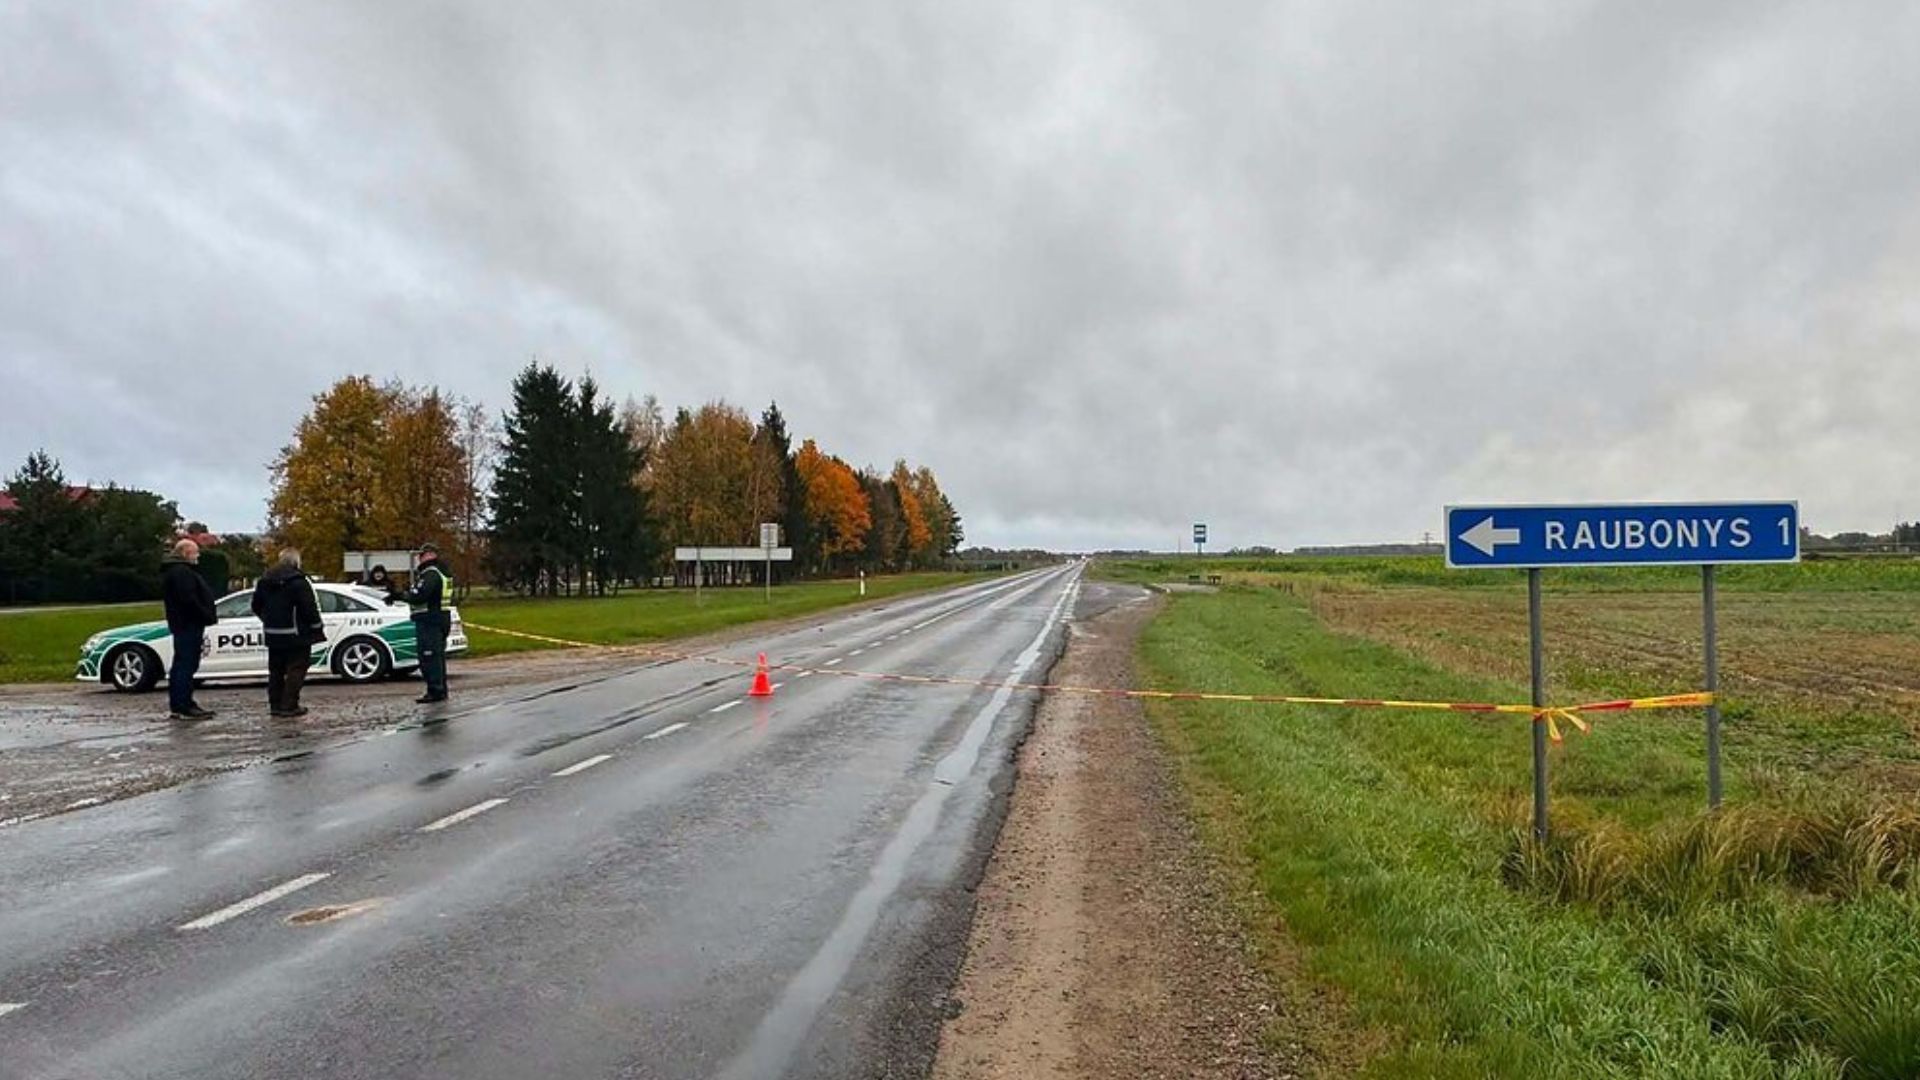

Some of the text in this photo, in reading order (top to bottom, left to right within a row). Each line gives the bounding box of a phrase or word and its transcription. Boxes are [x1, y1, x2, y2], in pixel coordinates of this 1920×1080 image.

[1545, 517, 1791, 550] RAUBONYS 1
[218, 633, 264, 648] POLI
